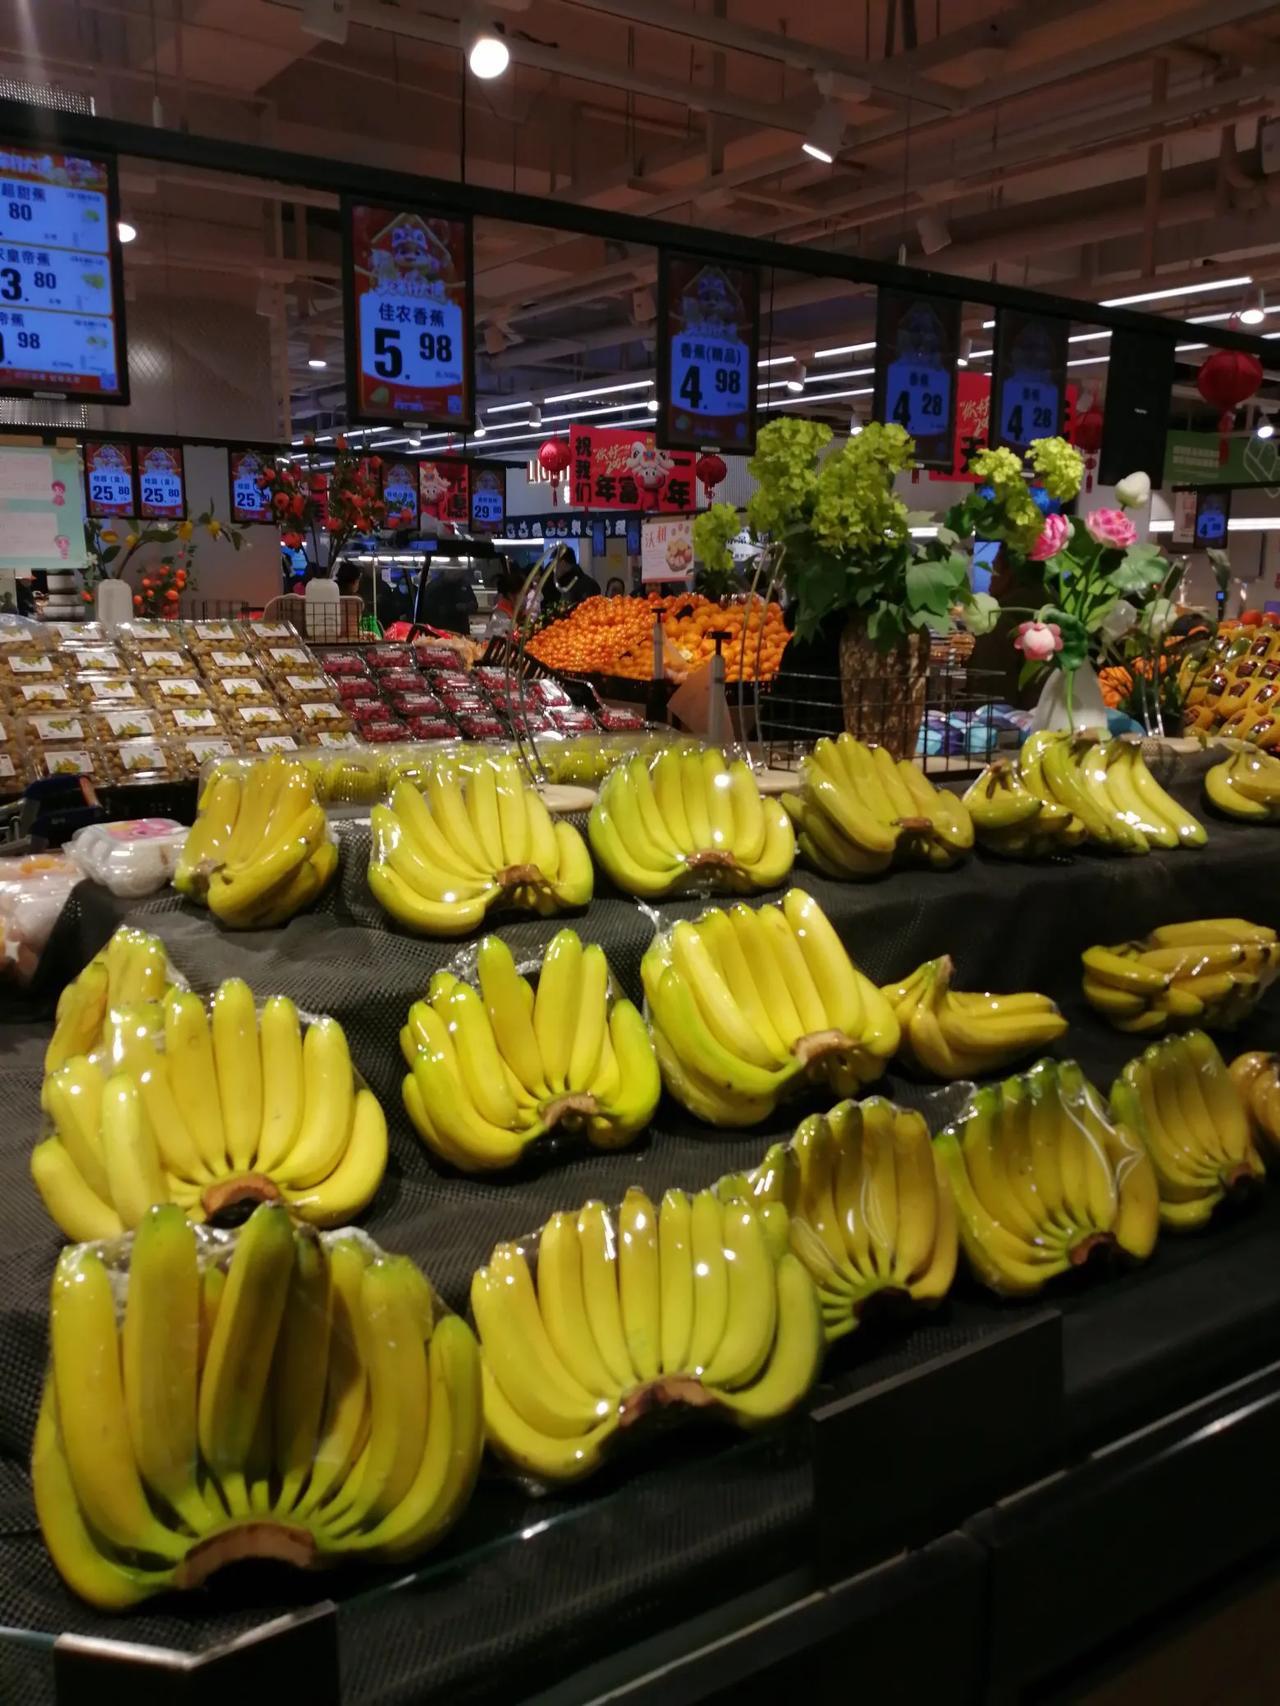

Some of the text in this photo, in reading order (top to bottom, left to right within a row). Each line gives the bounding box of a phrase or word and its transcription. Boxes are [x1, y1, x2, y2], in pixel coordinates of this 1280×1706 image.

[9, 202, 32, 221] 80
[378, 302, 445, 328] 佳农香蕉
[17, 331, 41, 349] 98
[575, 436, 592, 503] 祝我们
